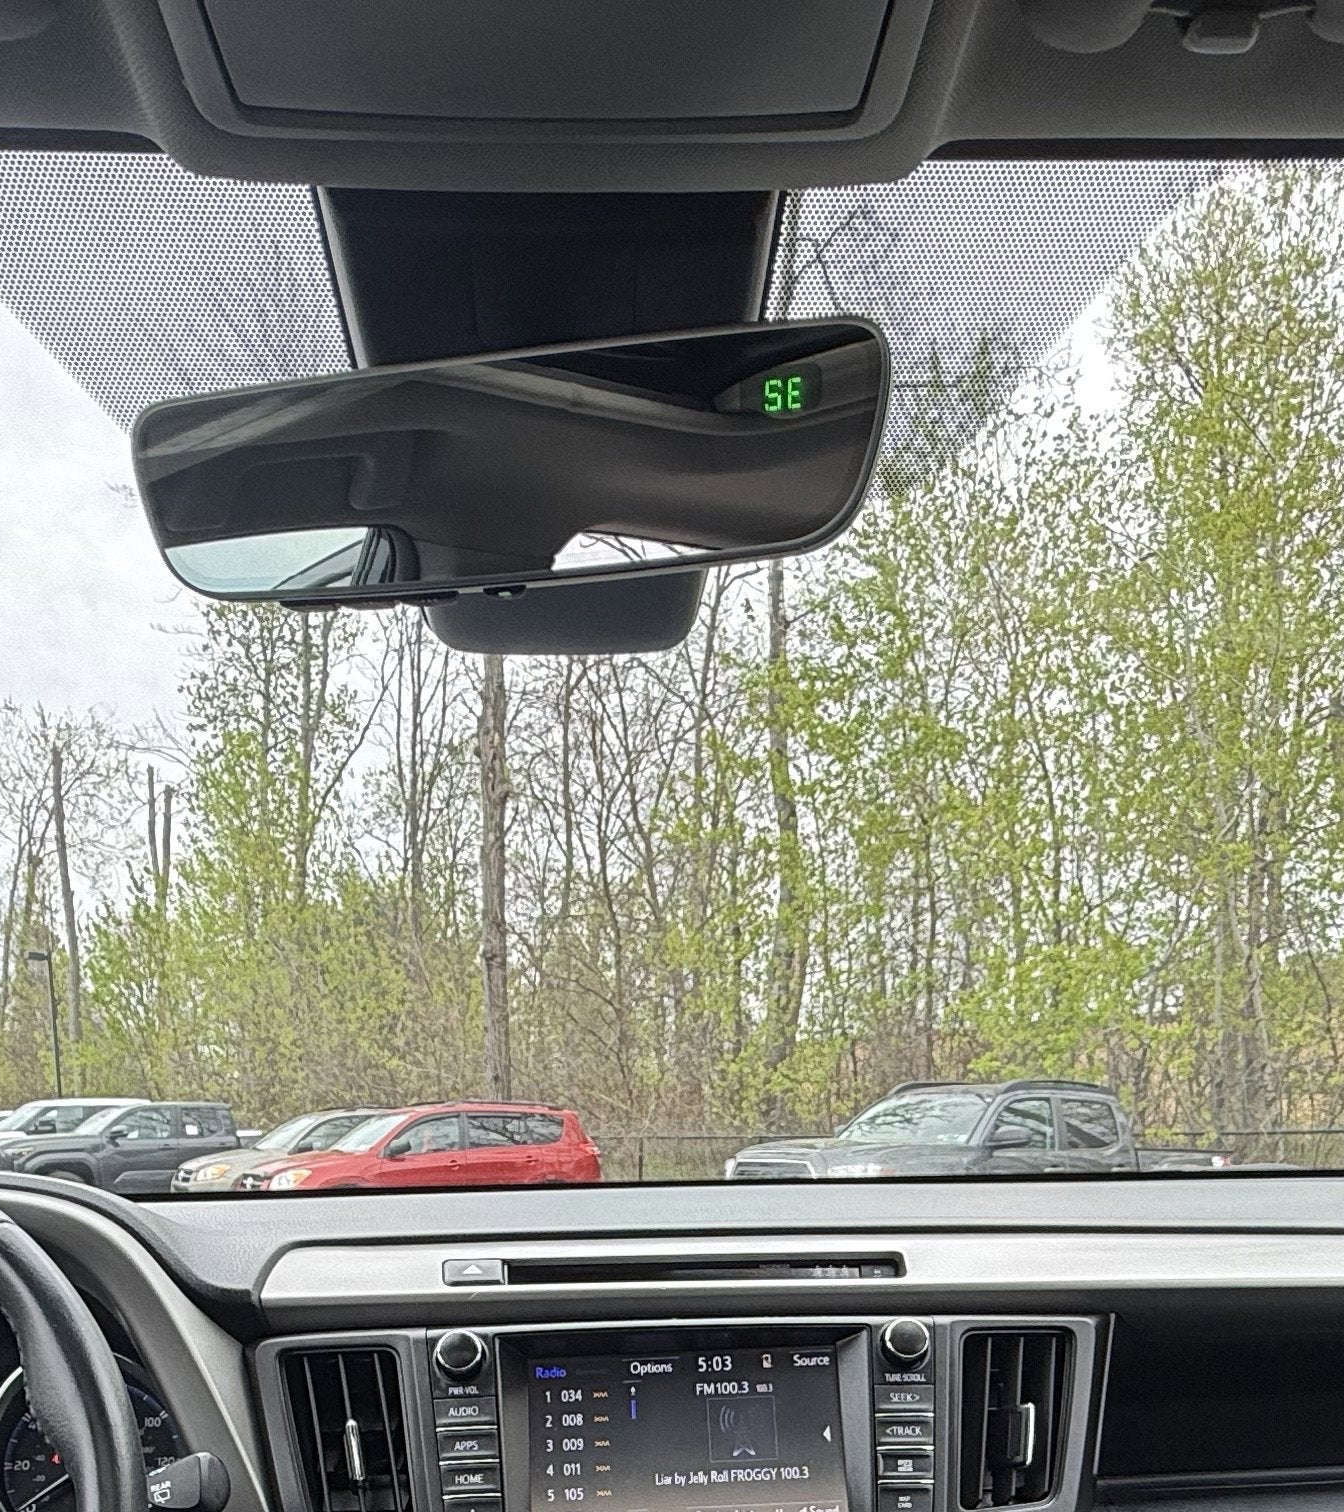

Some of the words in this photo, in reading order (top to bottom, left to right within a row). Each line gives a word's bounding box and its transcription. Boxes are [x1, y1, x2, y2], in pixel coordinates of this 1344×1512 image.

[764, 376, 802, 412] SE
[697, 1356, 733, 1372] 5:03
[792, 1353, 831, 1367] Source
[535, 1366, 567, 1379] Radio
[630, 1361, 673, 1376] Options
[545, 1391, 551, 1403] 1
[561, 1389, 583, 1402] 034
[448, 1405, 479, 1417] AUDIO
[144, 1416, 162, 1428] 100
[545, 1415, 553, 1428] 2
[562, 1413, 584, 1427] 008
[454, 1440, 479, 1451] APPS
[546, 1439, 554, 1452] 3
[562, 1438, 585, 1451] 009
[13, 1460, 31, 1471] 20
[546, 1464, 554, 1477] 4
[563, 1463, 581, 1476] 011
[455, 1474, 485, 1484] HOME
[655, 1472, 673, 1486] Liar
[675, 1472, 686, 1487] by
[688, 1470, 708, 1486] Jelly
[710, 1470, 729, 1483] Roll
[730, 1467, 778, 1482] FROGGY
[780, 1466, 810, 1480] 100.3
[150, 1480, 172, 1493] REAR
[547, 1489, 555, 1502] 5
[564, 1488, 584, 1501] 105
